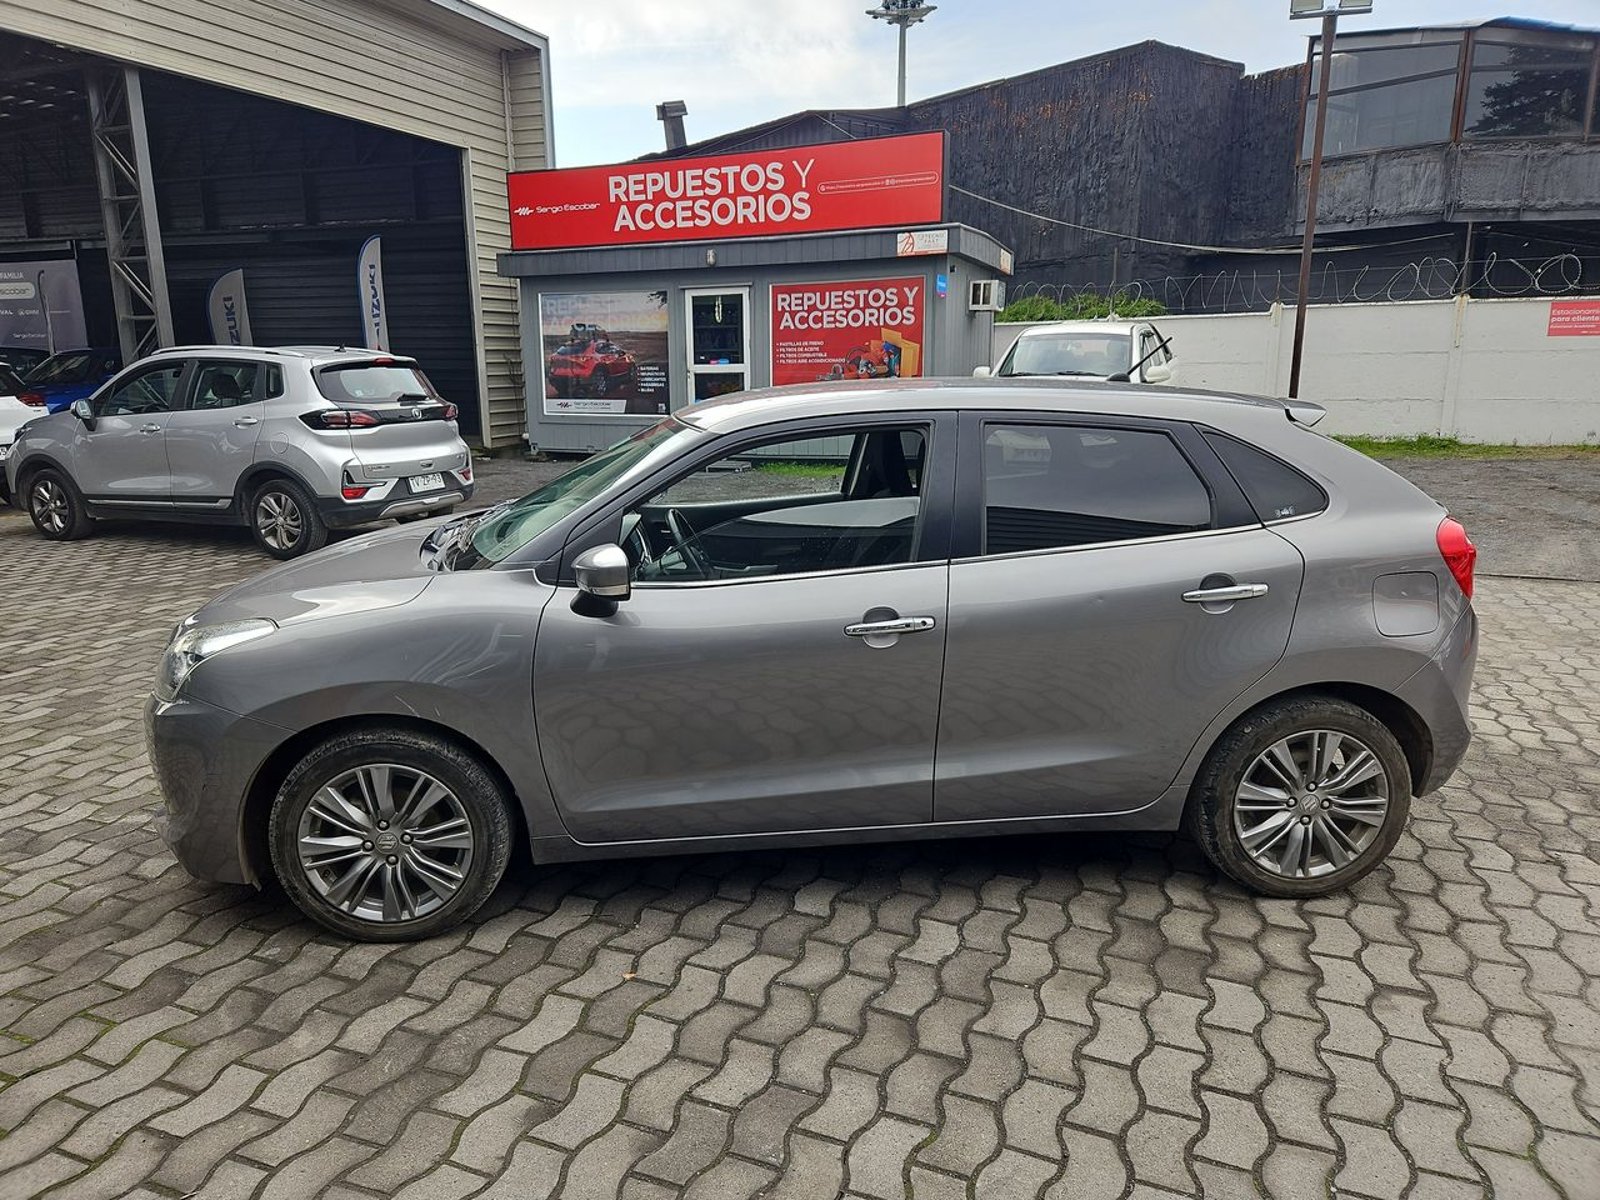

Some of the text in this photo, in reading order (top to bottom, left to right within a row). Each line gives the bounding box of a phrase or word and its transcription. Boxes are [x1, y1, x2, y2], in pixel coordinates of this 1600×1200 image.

[608, 158, 815, 202] REPUESTOS Y
[564, 203, 600, 211] Escobar
[614, 191, 812, 232] ACCESORIOS
[777, 286, 919, 311] REPUESTOS Y
[779, 307, 916, 330] ACCESORIOS
